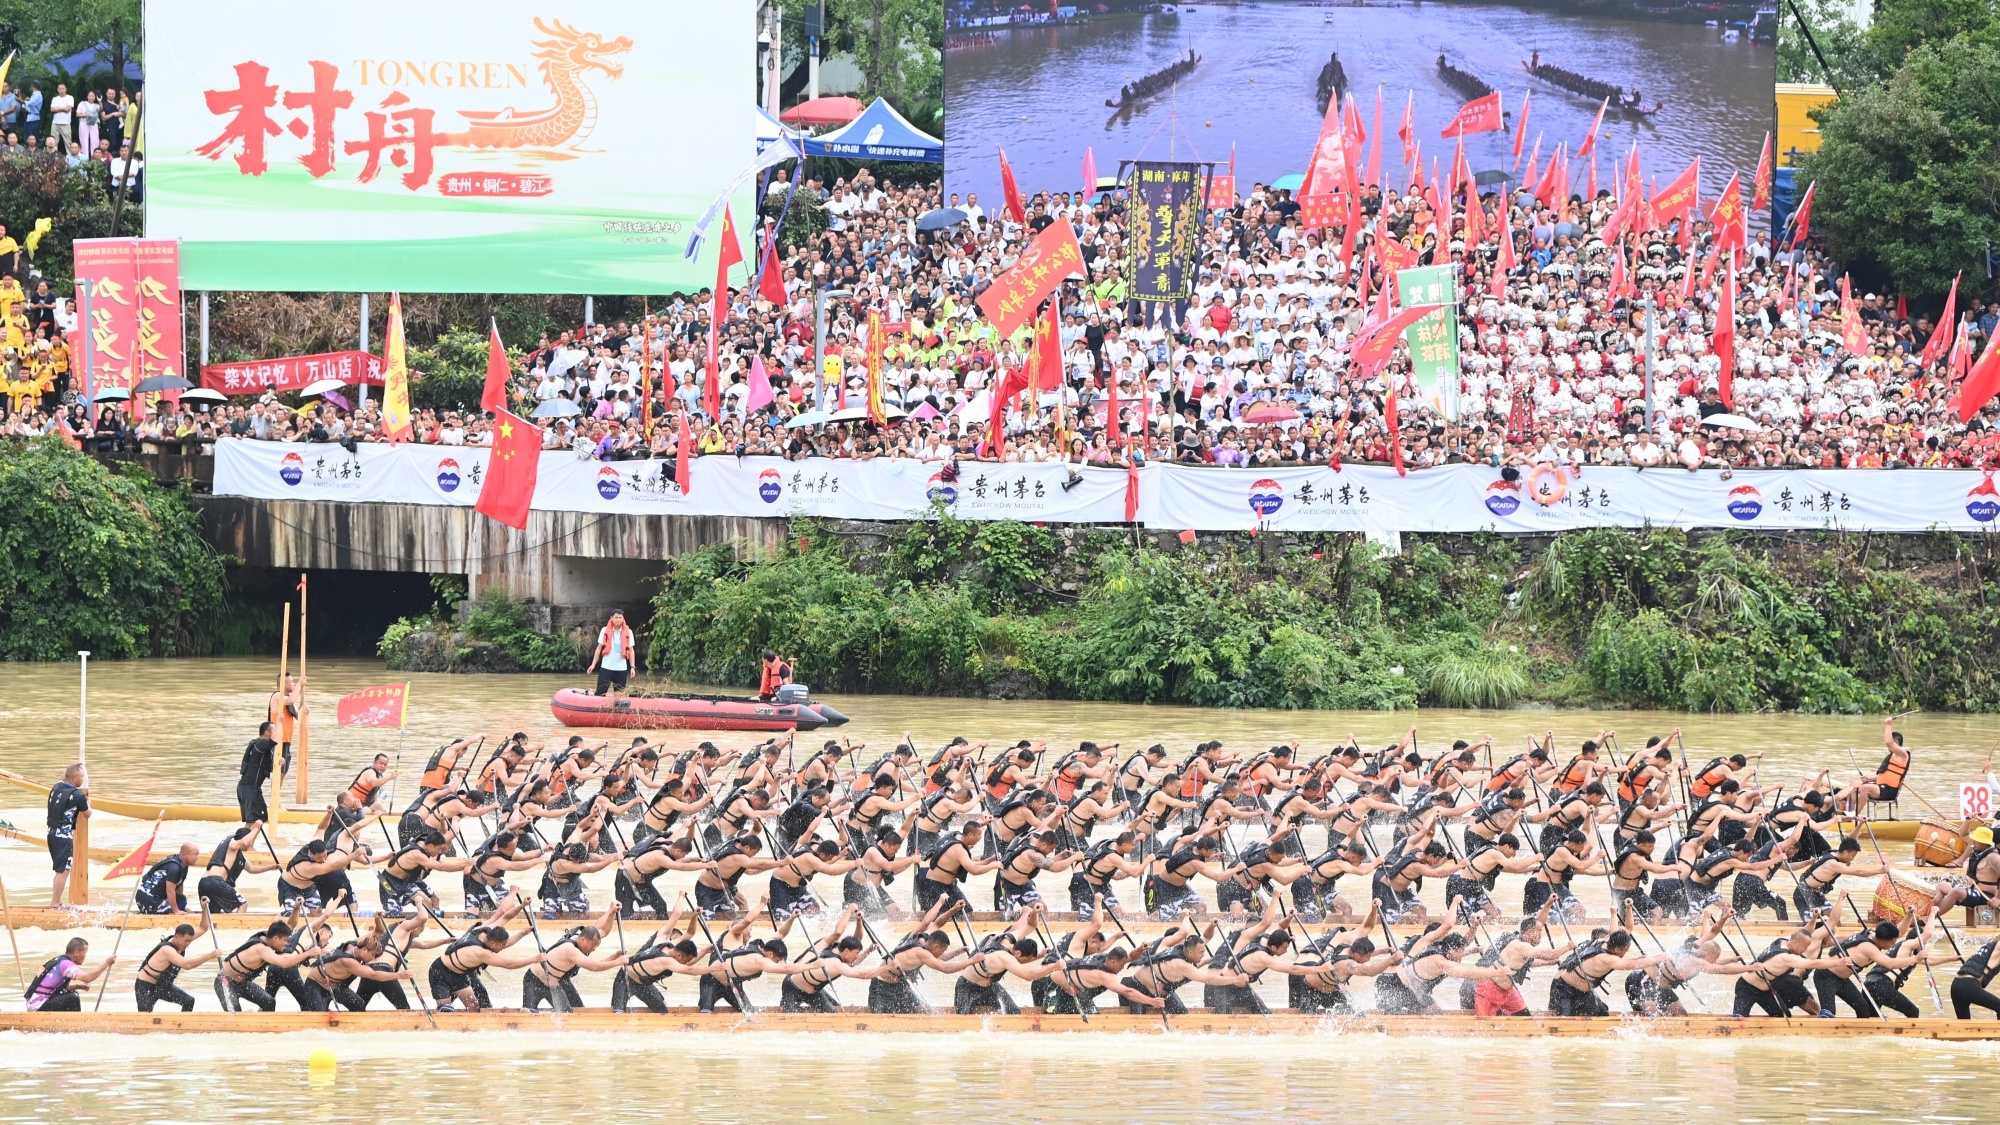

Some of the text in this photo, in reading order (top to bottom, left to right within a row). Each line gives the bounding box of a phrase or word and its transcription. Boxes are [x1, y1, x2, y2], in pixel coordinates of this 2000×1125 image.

[353, 59, 528, 89] TONGREN
[194, 60, 445, 192] 村舟
[833, 144, 860, 153] 补水啦
[968, 473, 1046, 500] 贵州茅台
[1773, 486, 1851, 512] 贵州茅台
[1014, 502, 1044, 510] MOUTAI
[1963, 786, 1989, 819] 38
